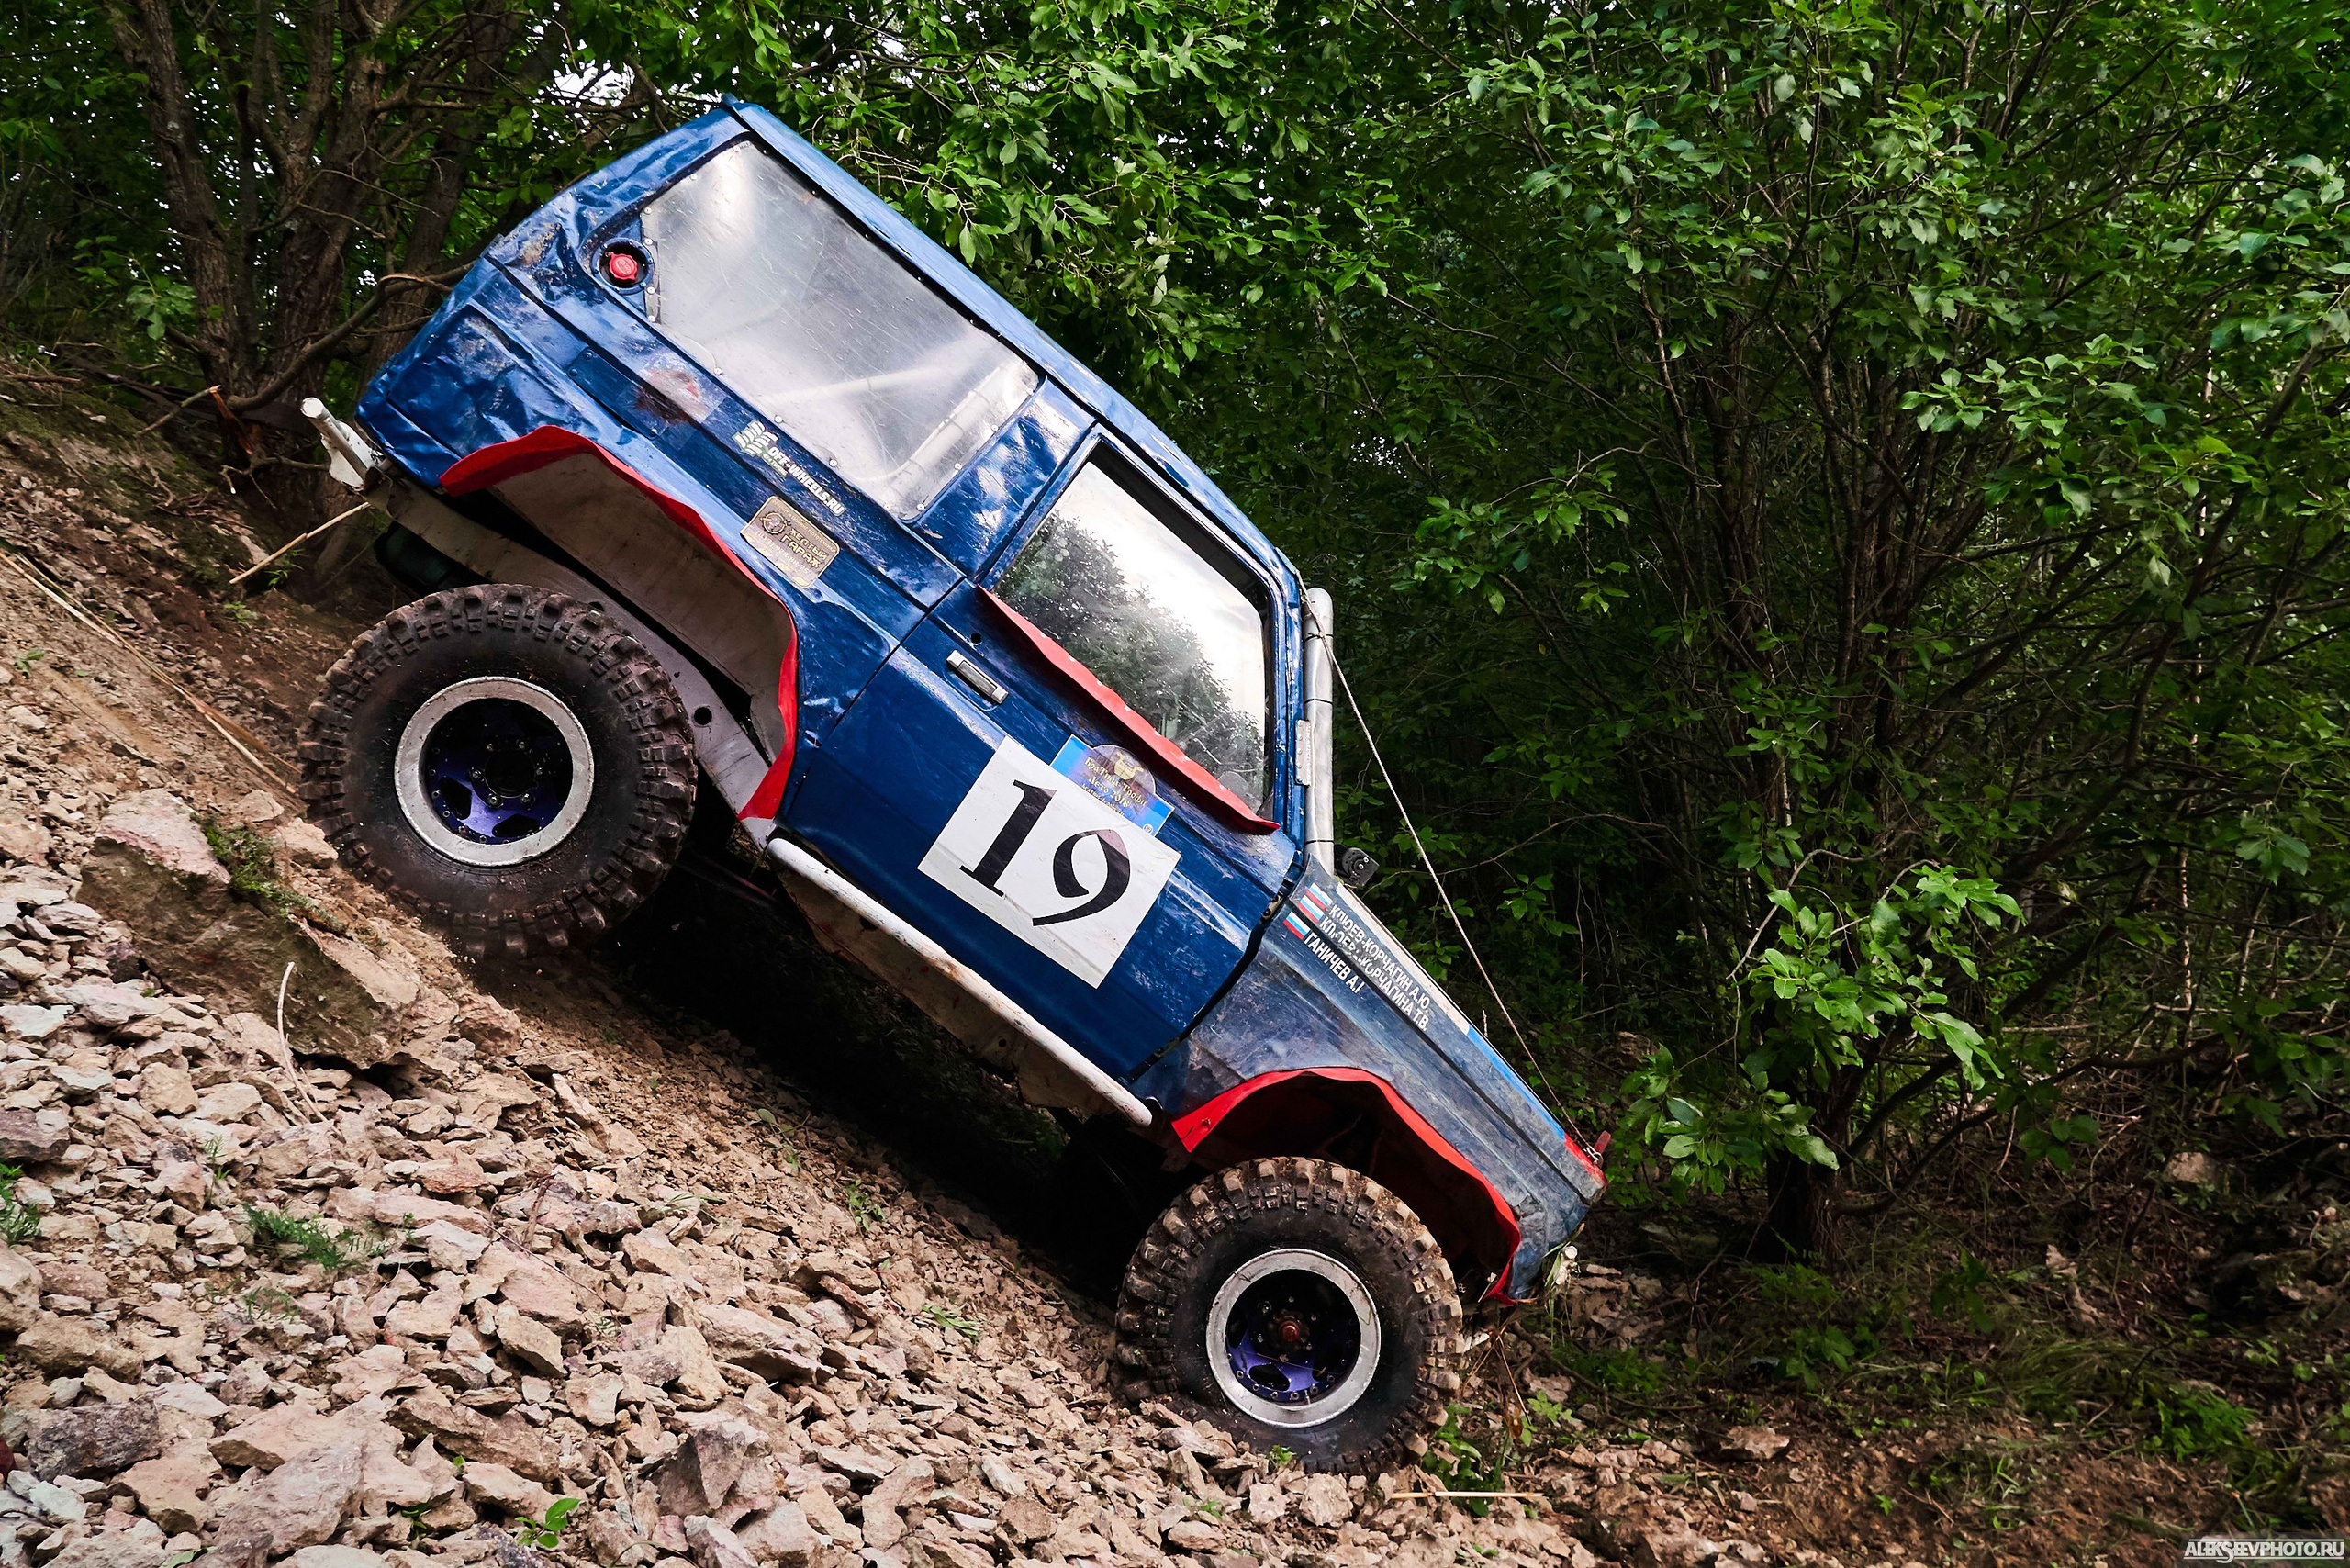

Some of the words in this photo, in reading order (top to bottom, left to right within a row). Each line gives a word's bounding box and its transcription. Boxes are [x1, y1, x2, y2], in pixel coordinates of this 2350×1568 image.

[768, 446, 845, 514] OFF-WHEELS.RU
[781, 534, 821, 568] ГАРАЖ
[789, 528, 828, 560] ЖЕЛТЫЙ
[1110, 790, 1131, 808] 2018
[959, 779, 1130, 926] 19
[1304, 932, 1351, 980] ГАНИЧЕВ
[1409, 988, 1430, 1013] А.Ю.
[1412, 1010, 1429, 1031] Т.В.
